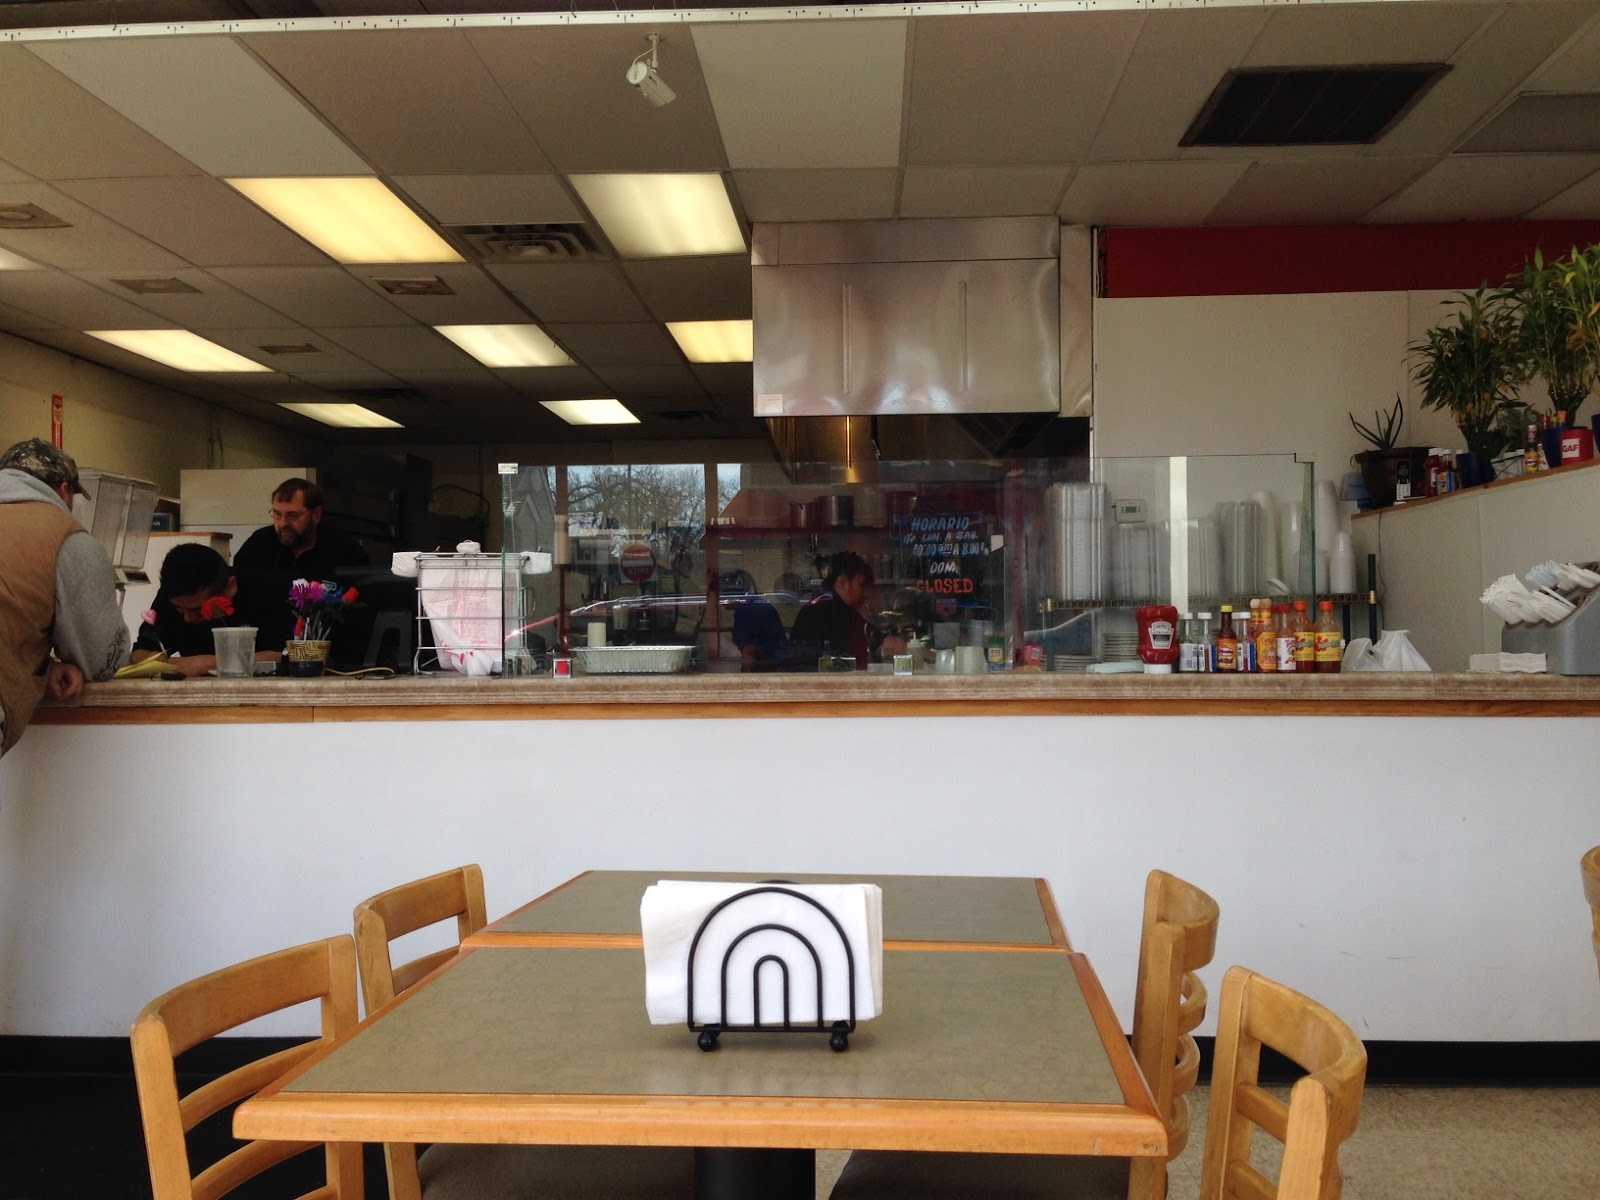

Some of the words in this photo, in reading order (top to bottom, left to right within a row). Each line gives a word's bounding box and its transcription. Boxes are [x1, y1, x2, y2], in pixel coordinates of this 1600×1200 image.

[1562, 444, 1579, 453] GAF
[911, 517, 970, 531] HORARIO
[915, 578, 975, 593] CLOSED
